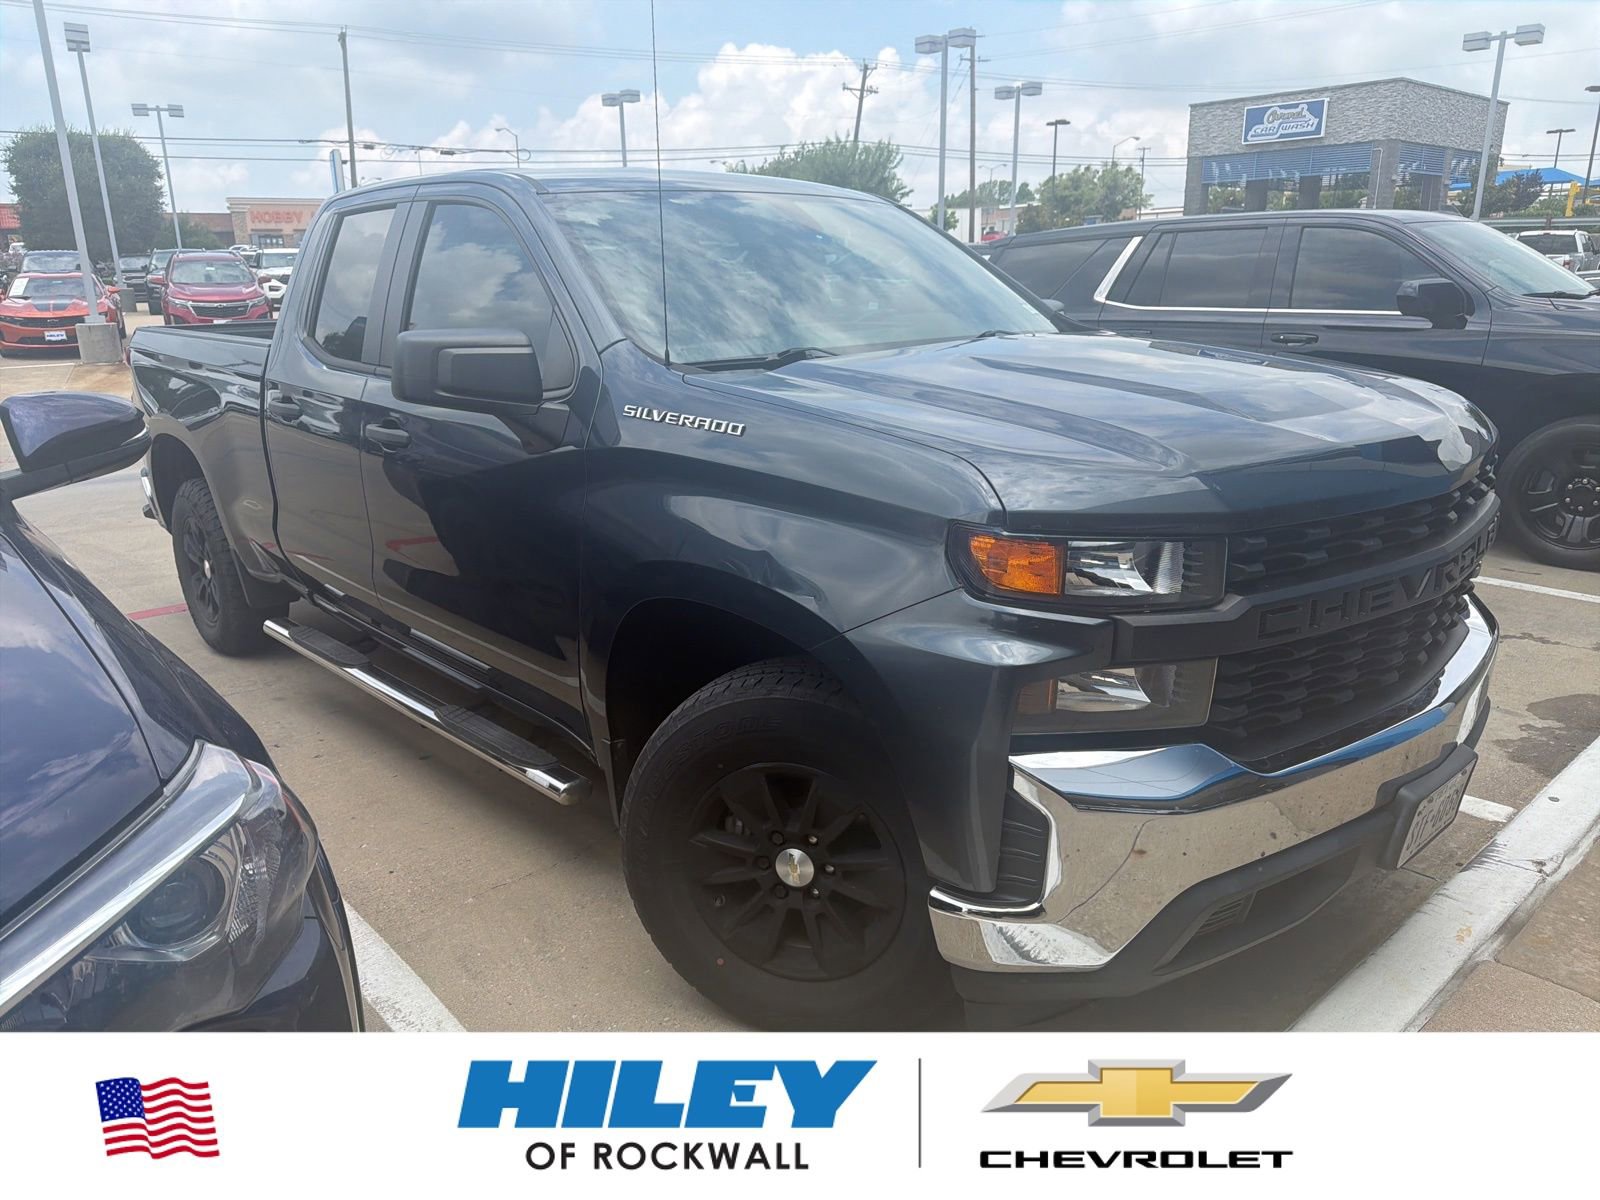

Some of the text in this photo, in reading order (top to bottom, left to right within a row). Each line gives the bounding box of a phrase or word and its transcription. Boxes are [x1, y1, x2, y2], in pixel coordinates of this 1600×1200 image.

[1253, 121, 1314, 134] CAR WASH
[250, 210, 304, 224] HOBBY
[622, 404, 746, 437] SILVERADO
